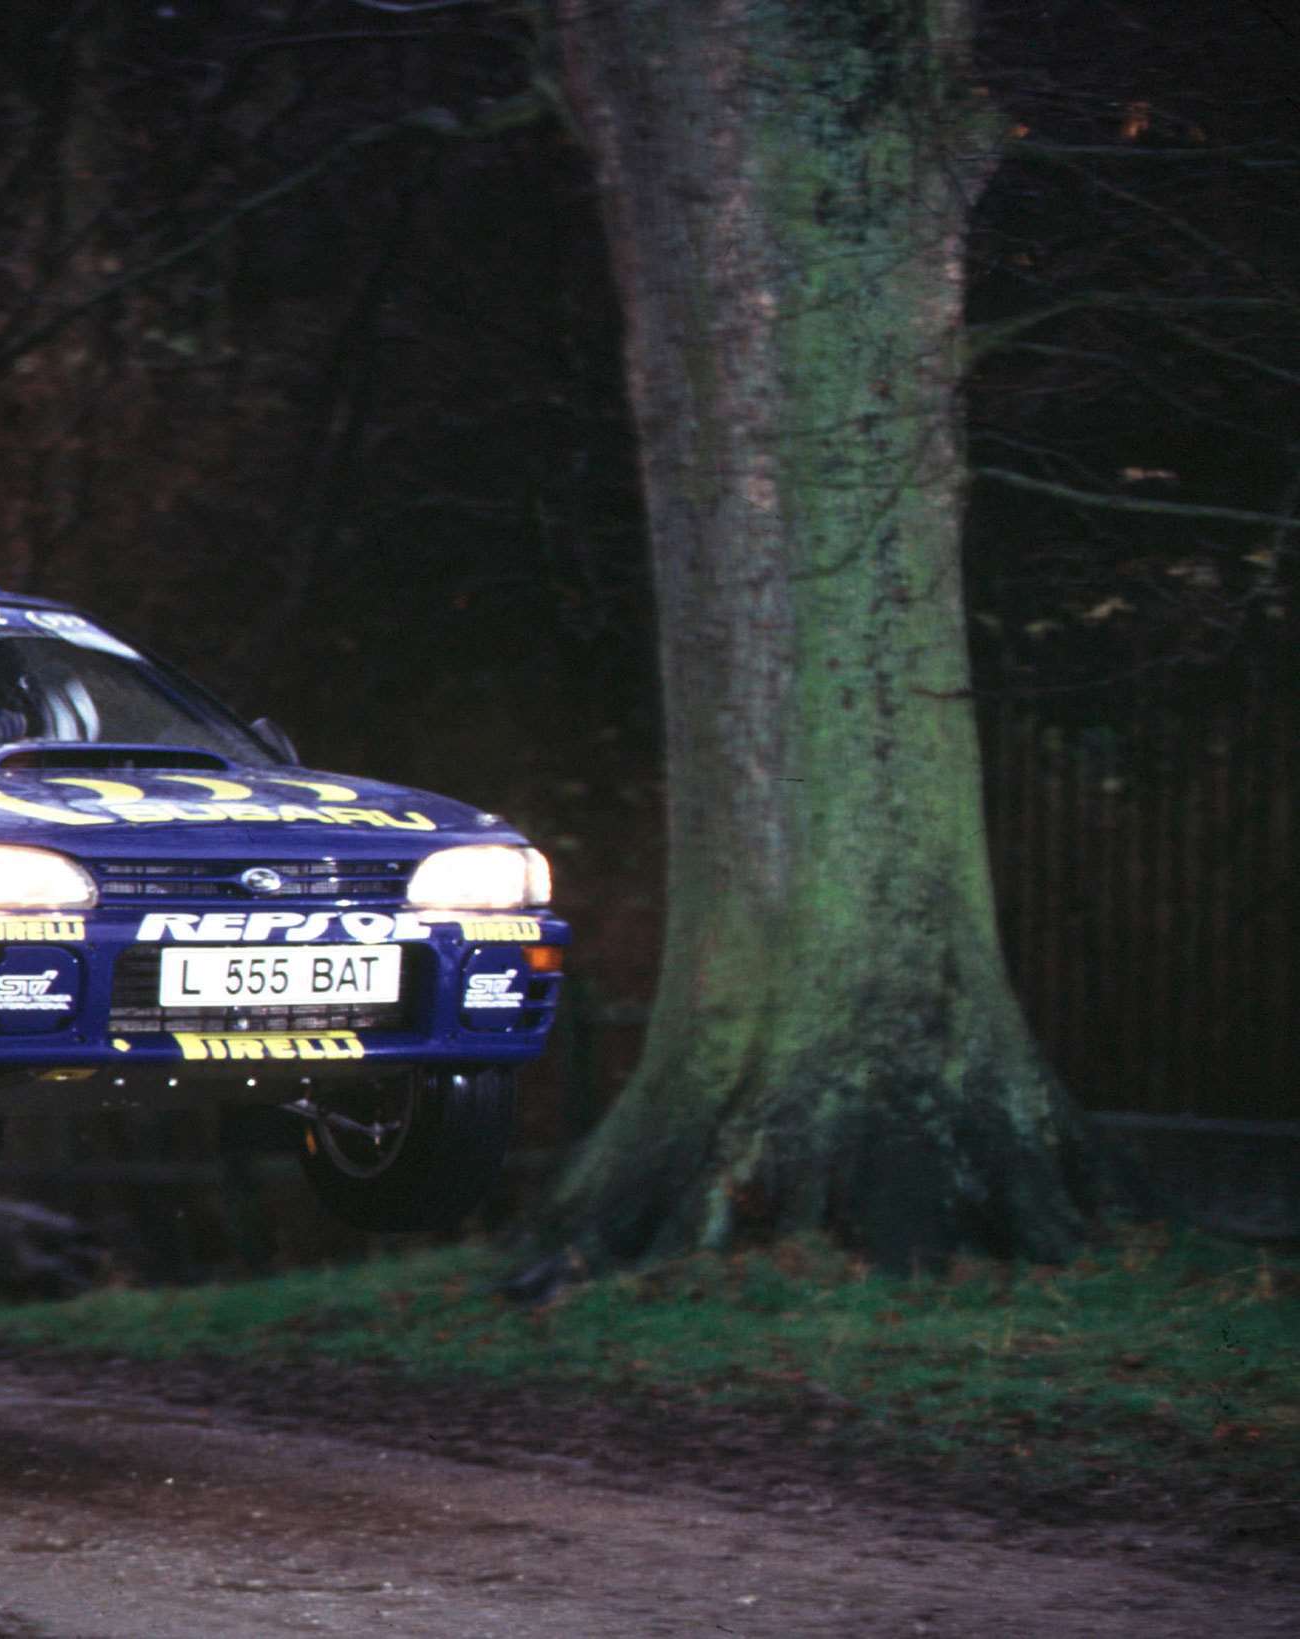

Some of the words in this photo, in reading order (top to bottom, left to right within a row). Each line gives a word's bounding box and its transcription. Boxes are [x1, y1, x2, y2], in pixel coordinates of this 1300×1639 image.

[108, 803, 436, 831] SUBARU
[136, 912, 431, 944] REPSOL
[458, 915, 541, 941] PIRELLI
[181, 959, 201, 995] L
[225, 958, 289, 995] 555
[311, 956, 380, 994] BAT
[173, 1031, 366, 1060] PIRELLI
